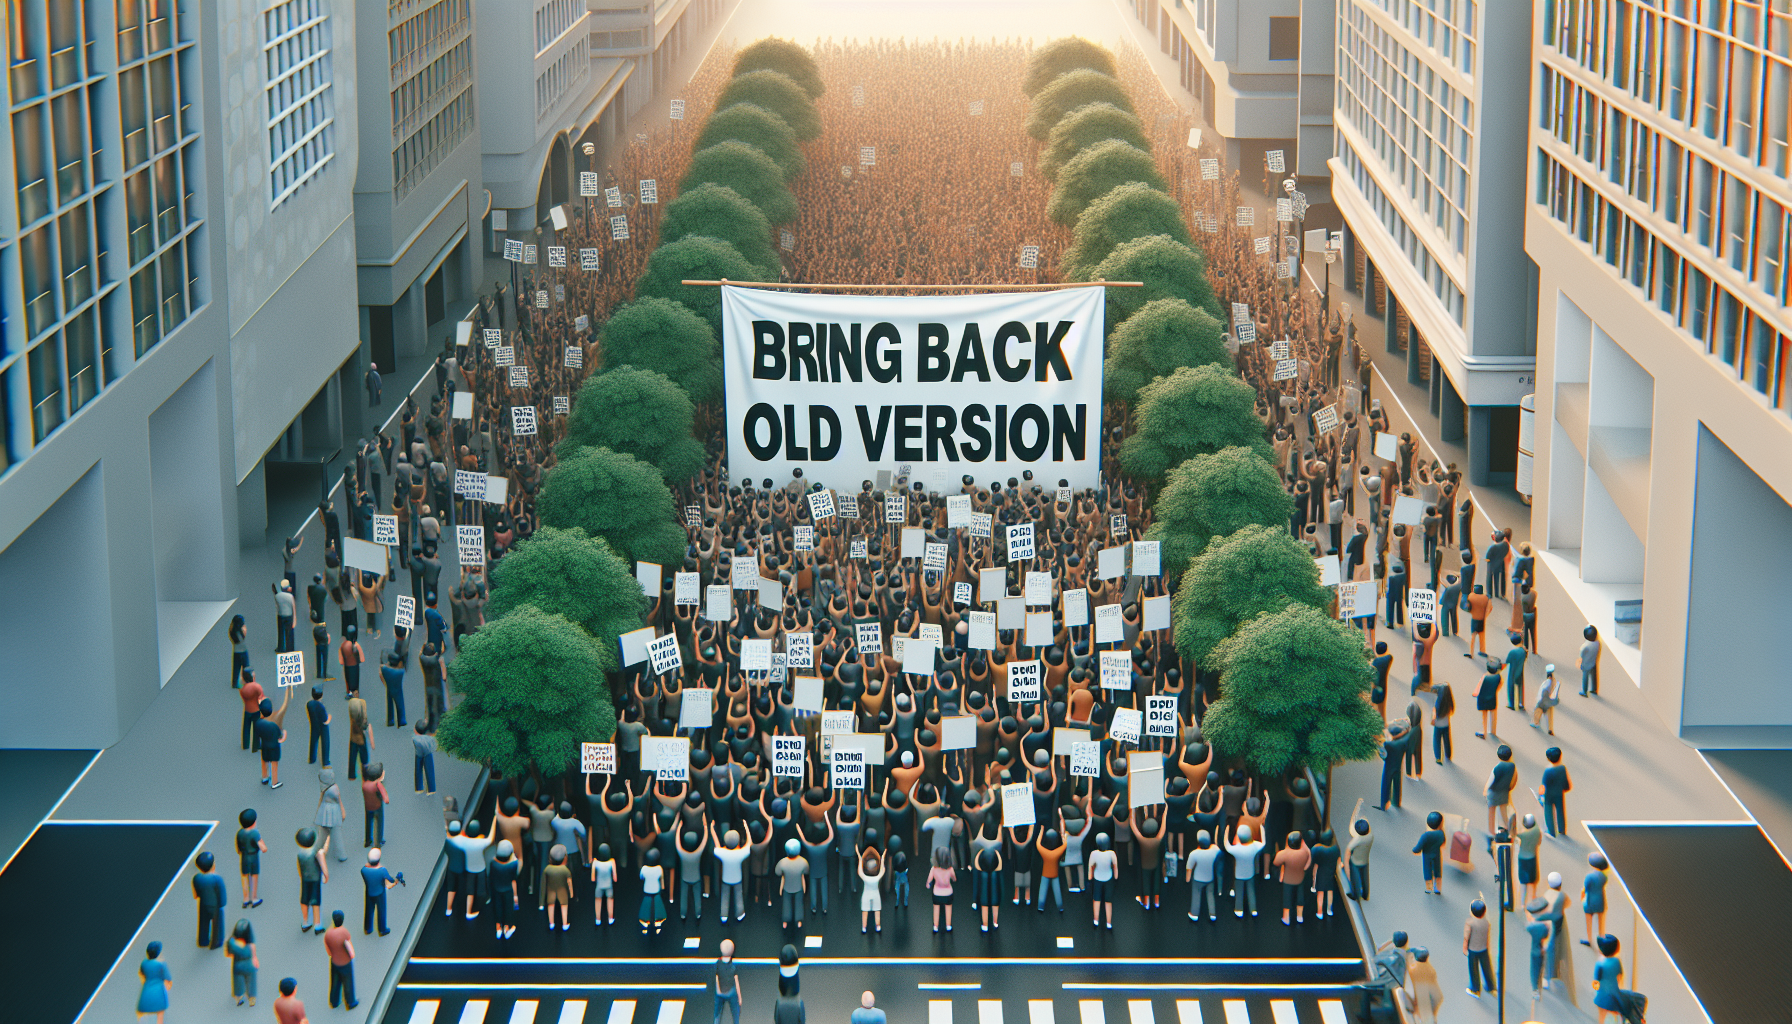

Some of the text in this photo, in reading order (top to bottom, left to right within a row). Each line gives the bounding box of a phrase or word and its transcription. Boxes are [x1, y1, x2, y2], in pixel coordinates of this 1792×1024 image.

[752, 321, 1075, 383] BRING BACK
[743, 403, 1087, 462] OLD VERSION
